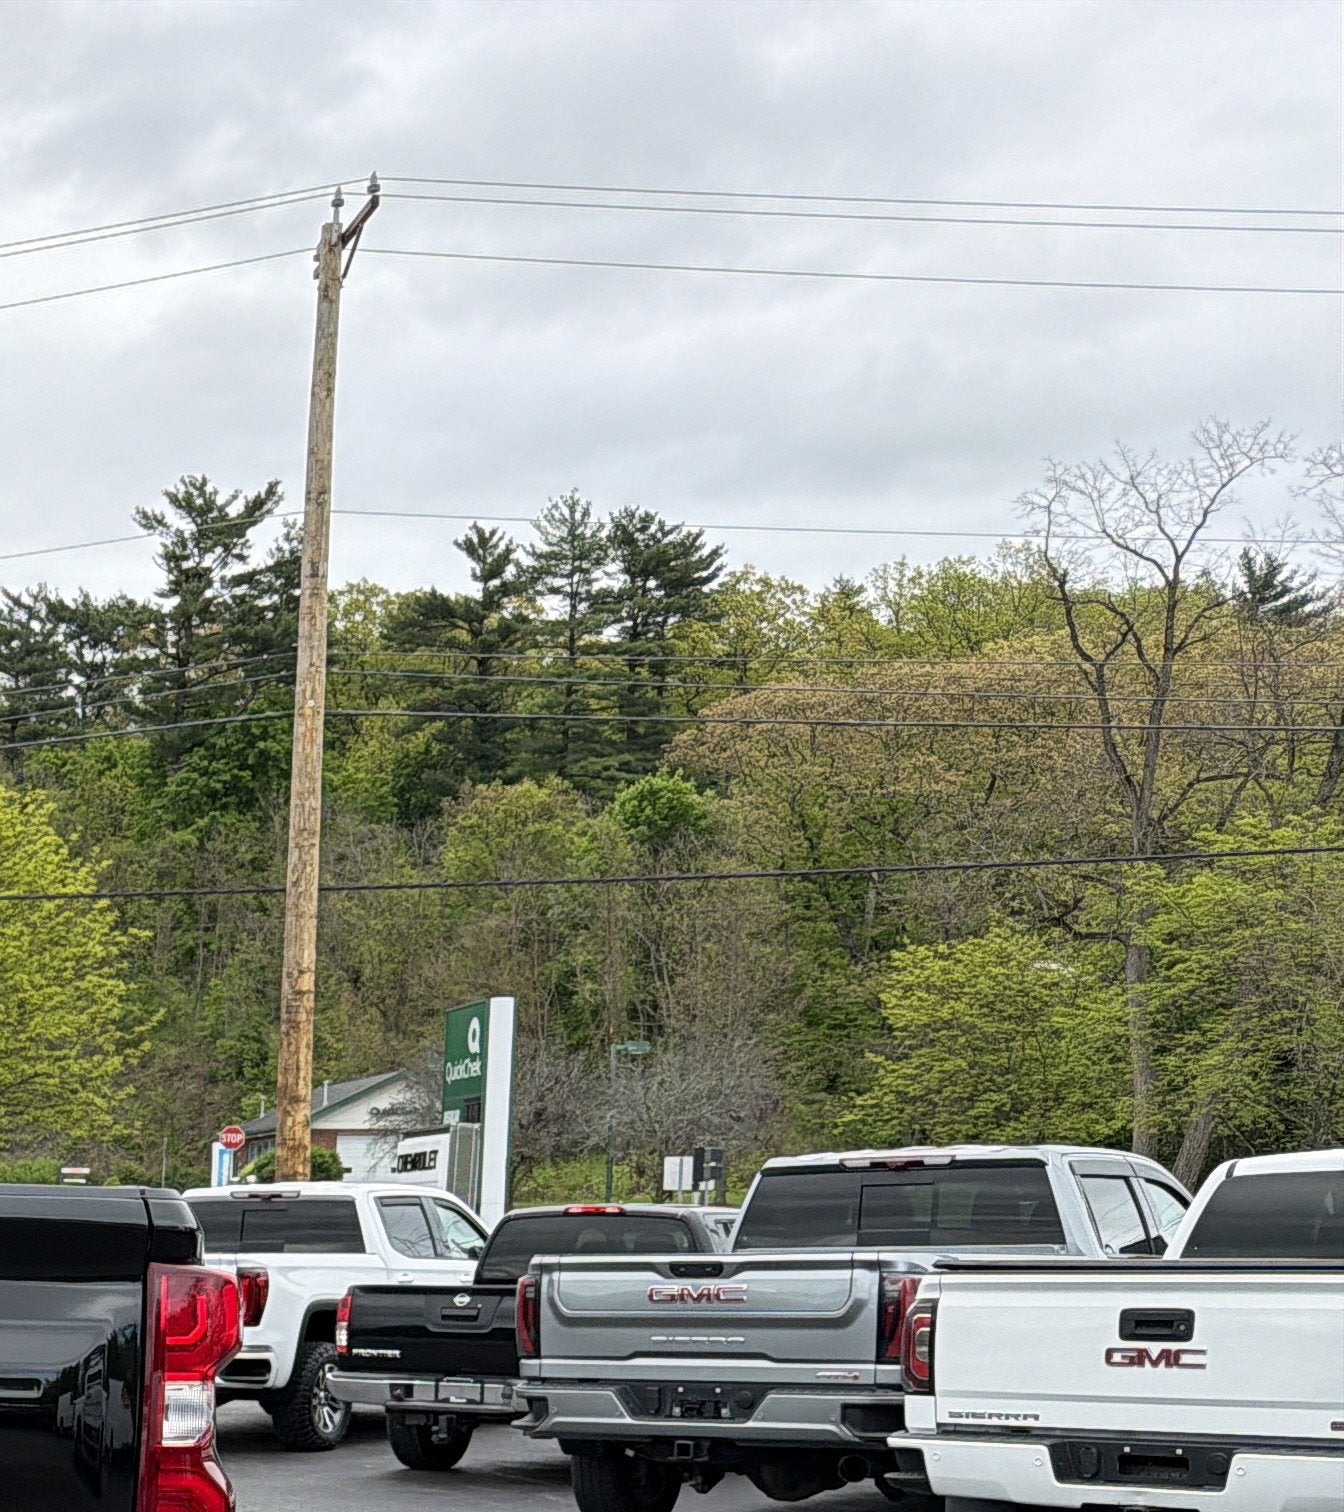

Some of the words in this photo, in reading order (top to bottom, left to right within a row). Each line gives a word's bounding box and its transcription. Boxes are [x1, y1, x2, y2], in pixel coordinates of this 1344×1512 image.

[445, 1056, 482, 1085] QuickChek
[221, 1132, 243, 1144] STOP
[647, 1284, 748, 1304] GMC
[351, 1348, 402, 1358] FRONTIER
[1105, 1347, 1208, 1369] GMC
[948, 1411, 1041, 1421] SIERRA
